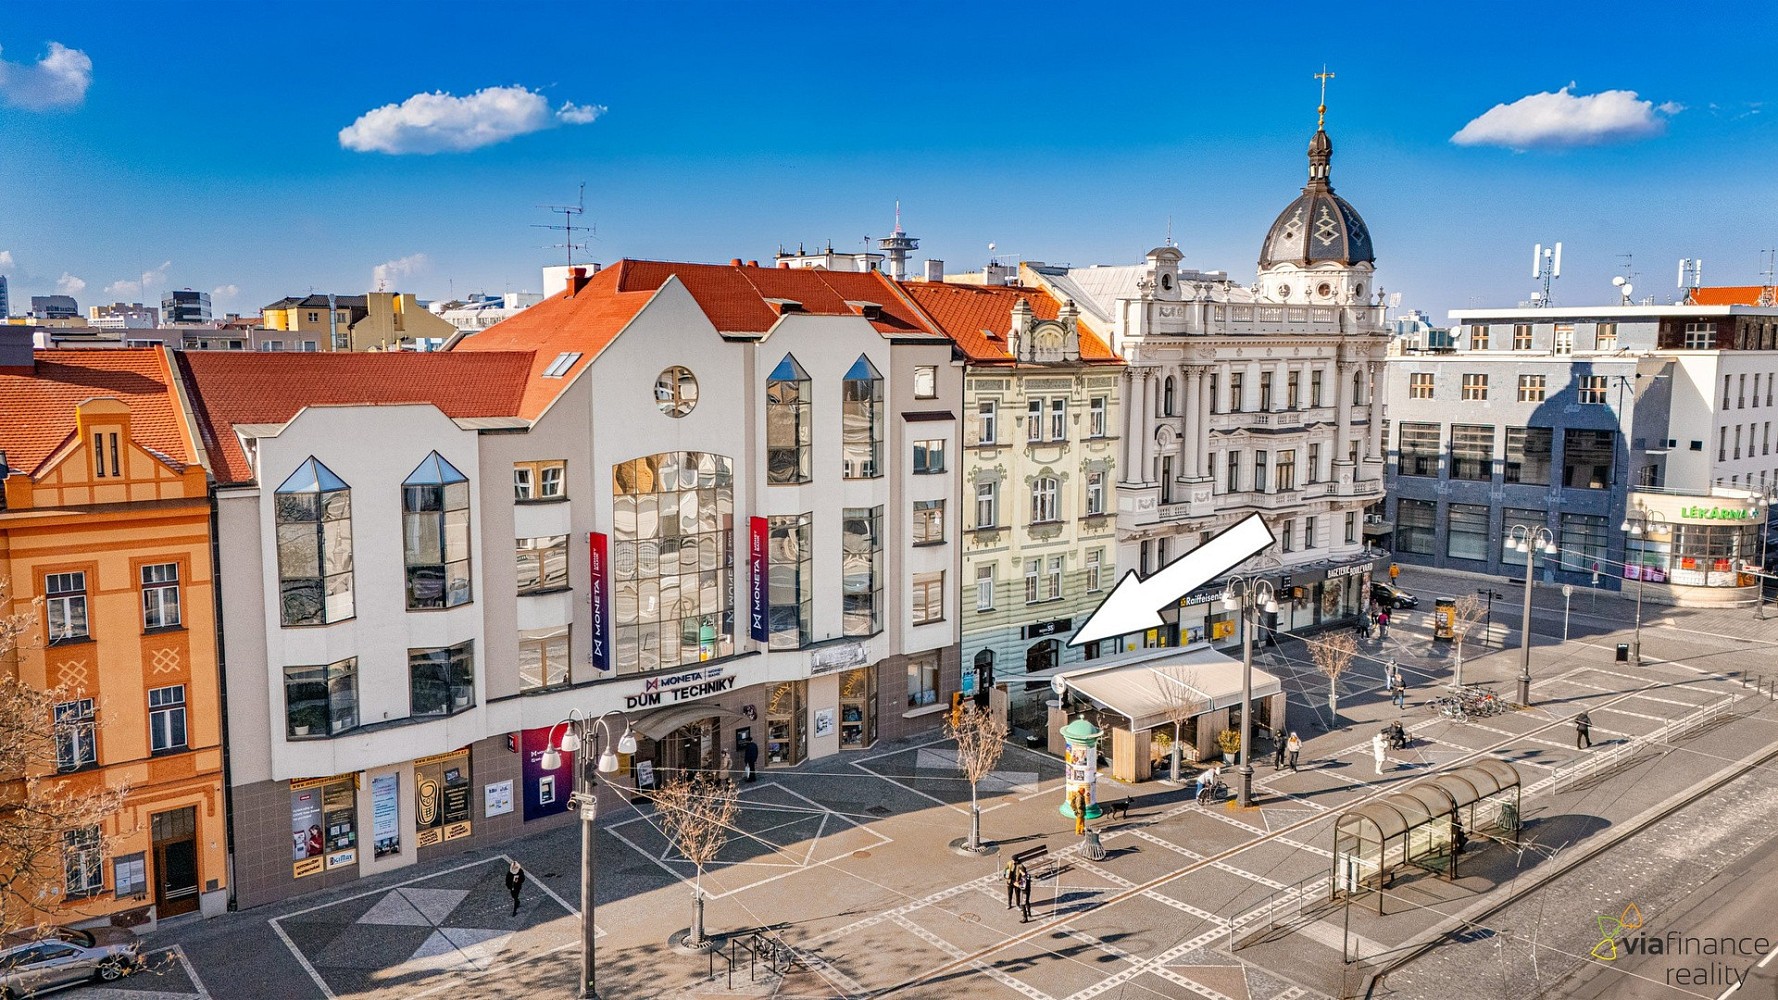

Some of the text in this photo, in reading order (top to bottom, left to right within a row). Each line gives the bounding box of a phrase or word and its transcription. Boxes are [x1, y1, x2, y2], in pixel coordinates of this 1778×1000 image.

[1681, 506, 1747, 520] LÉKÁRNA
[661, 672, 703, 687] MONETA
[627, 676, 736, 709] DŮM TECHNIKY
[769, 683, 790, 711] KNIHY
